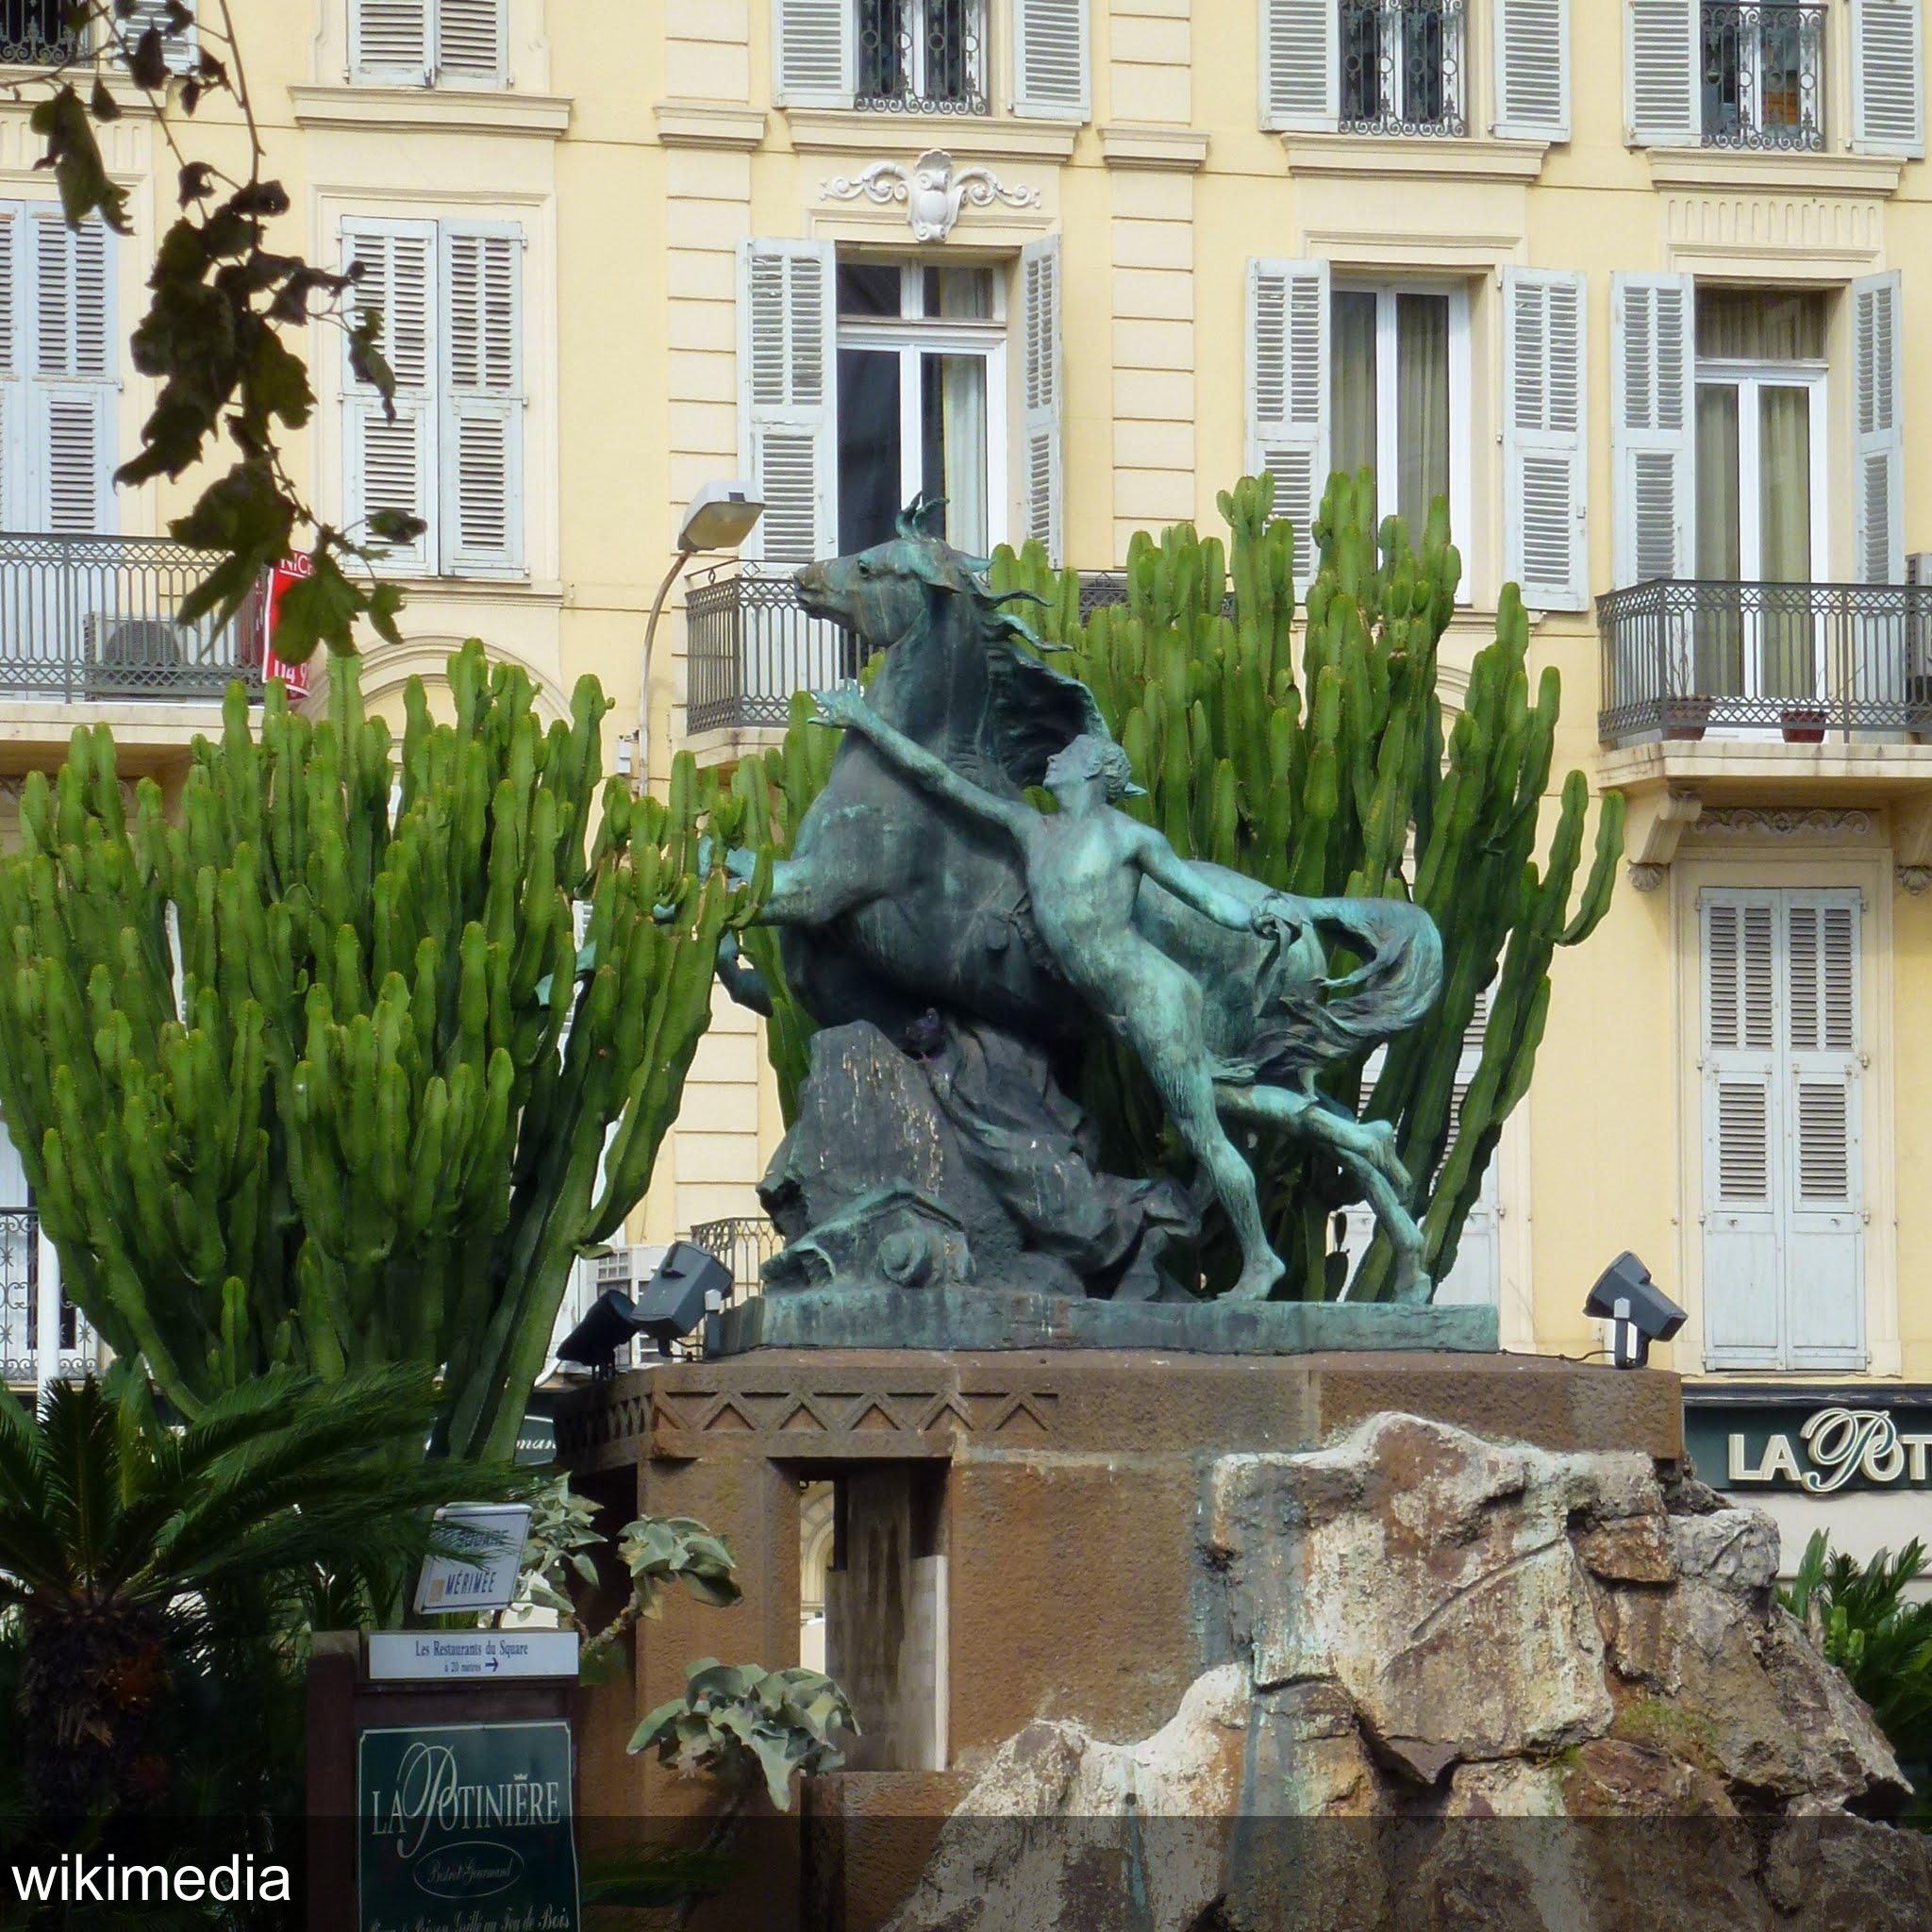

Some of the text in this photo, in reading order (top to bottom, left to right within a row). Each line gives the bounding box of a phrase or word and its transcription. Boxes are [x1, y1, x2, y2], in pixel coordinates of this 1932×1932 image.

[1728, 1433, 1802, 1481] LA
[415, 1639, 528, 1658] Les Restaurants du Square
[372, 1790, 407, 1836] LA
[538, 1902, 570, 1931] Bois
